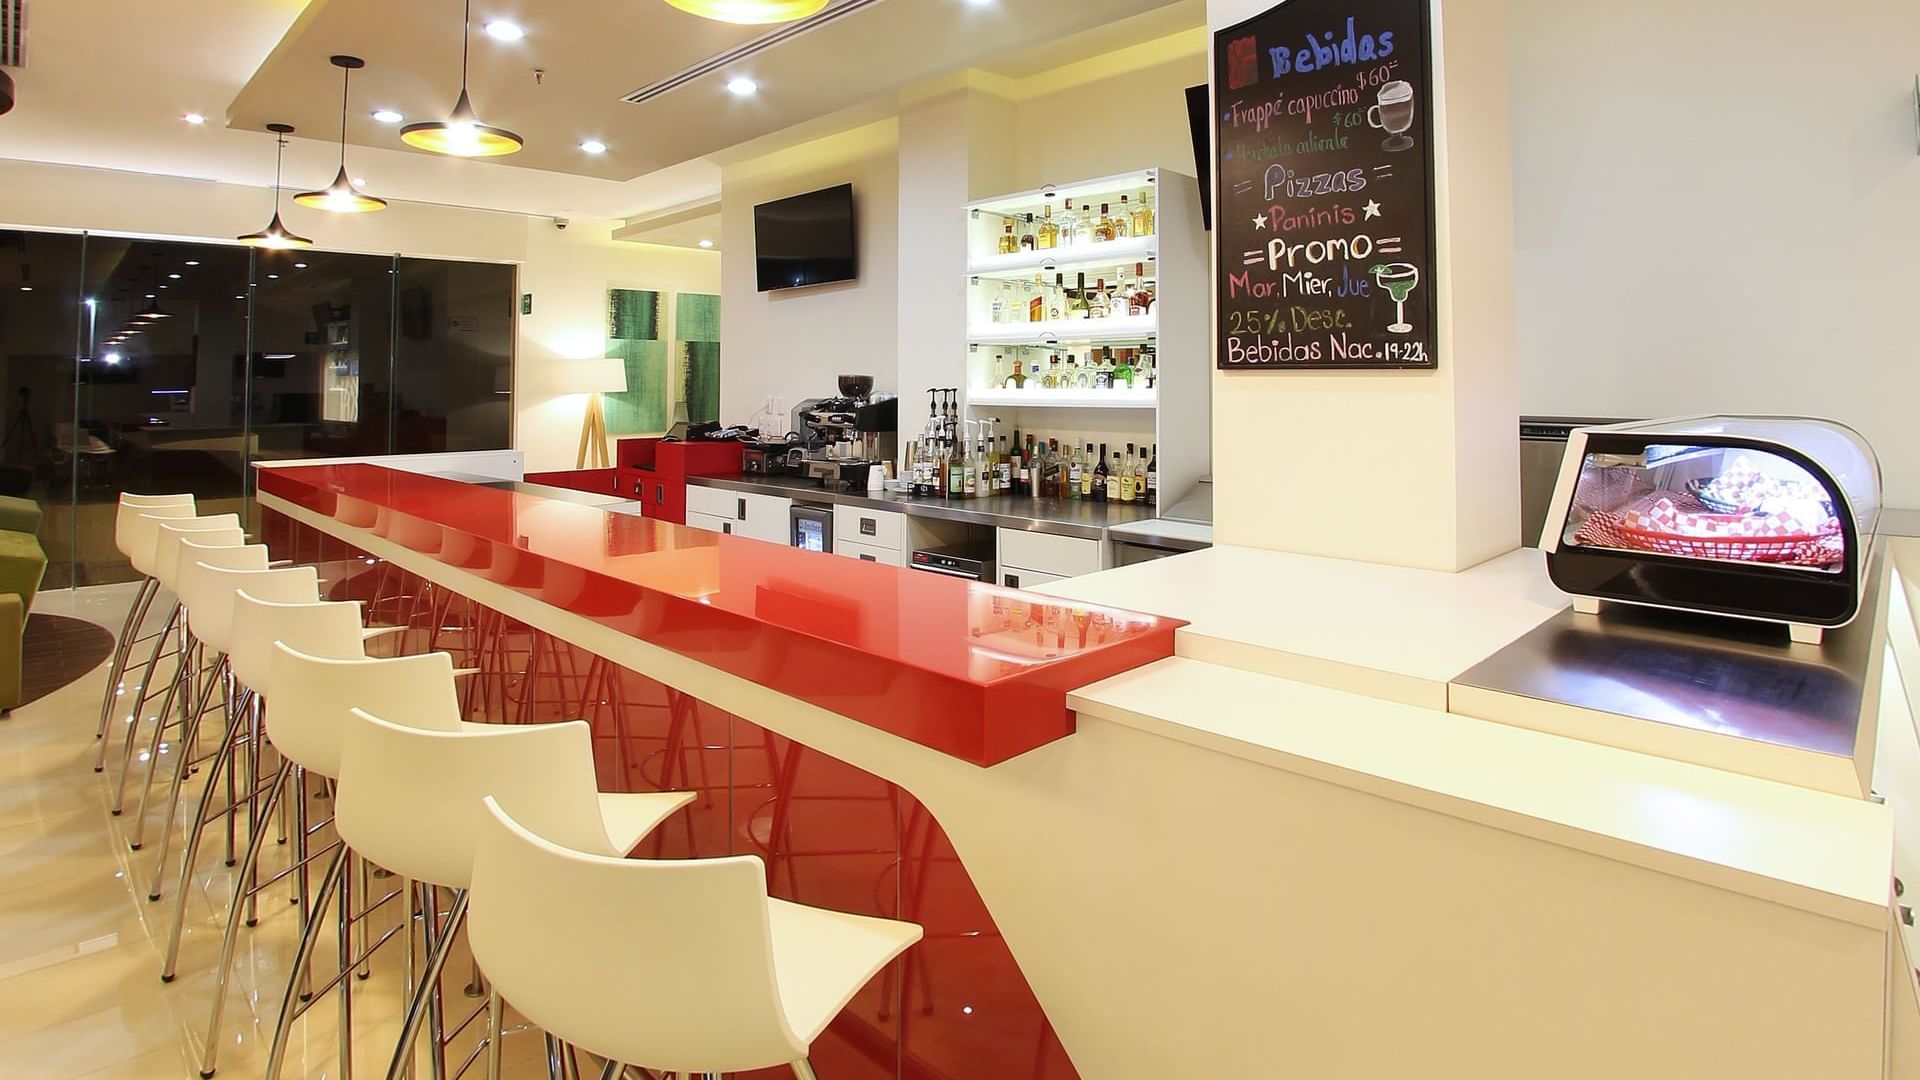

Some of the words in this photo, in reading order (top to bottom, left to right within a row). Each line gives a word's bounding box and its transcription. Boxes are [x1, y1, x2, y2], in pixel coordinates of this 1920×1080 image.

[1269, 16, 1394, 79] Bebidas
[1287, 84, 1359, 124] capuccino
[1264, 164, 1367, 200] Pizzas
[1269, 204, 1356, 232] Paninis
[1337, 265, 1371, 297] Jue
[1230, 308, 1286, 335] 25%
[1291, 306, 1352, 333] Desc.
[1228, 333, 1321, 363] Bebidas
